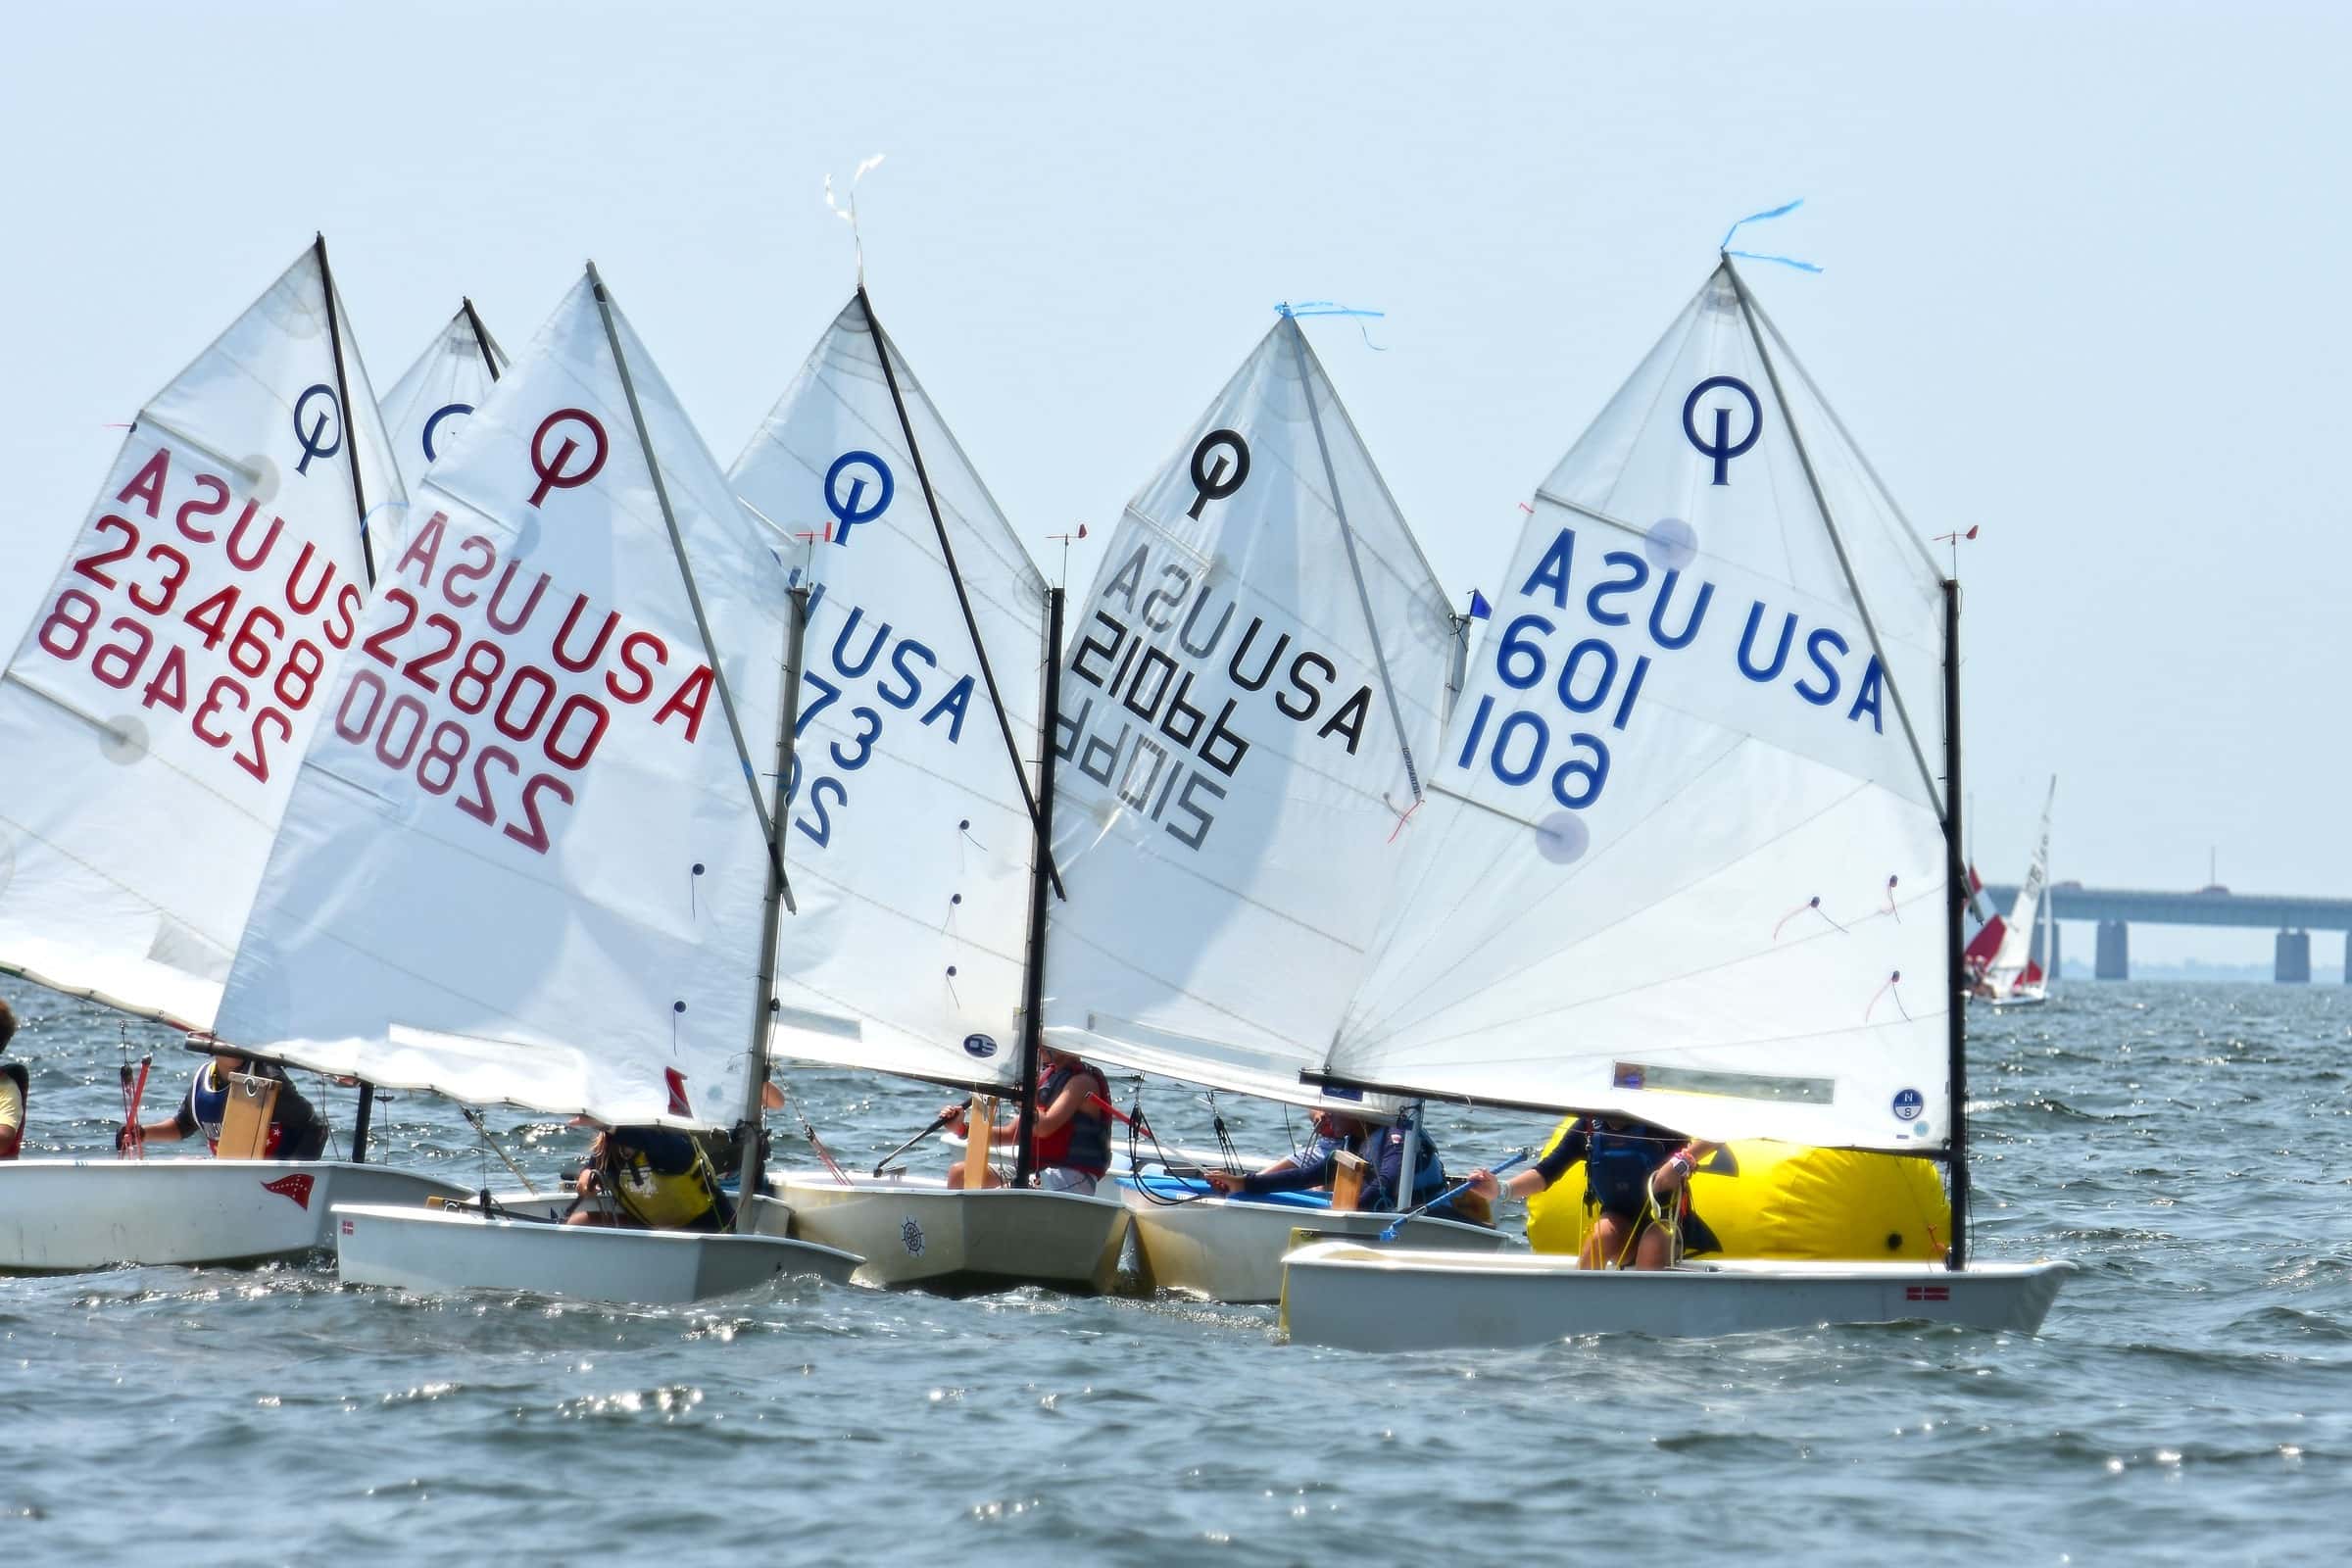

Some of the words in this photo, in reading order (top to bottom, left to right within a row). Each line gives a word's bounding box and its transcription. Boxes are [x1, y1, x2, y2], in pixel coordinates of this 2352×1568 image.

[72, 514, 324, 710] 23468
[362, 588, 611, 771] 22800
[552, 593, 717, 744] USA
[832, 606, 976, 745] USA
[1496, 614, 1651, 731] 601
[1738, 600, 1887, 735] USA
[1071, 610, 1250, 777] 21066
[1229, 616, 1372, 756] USA
